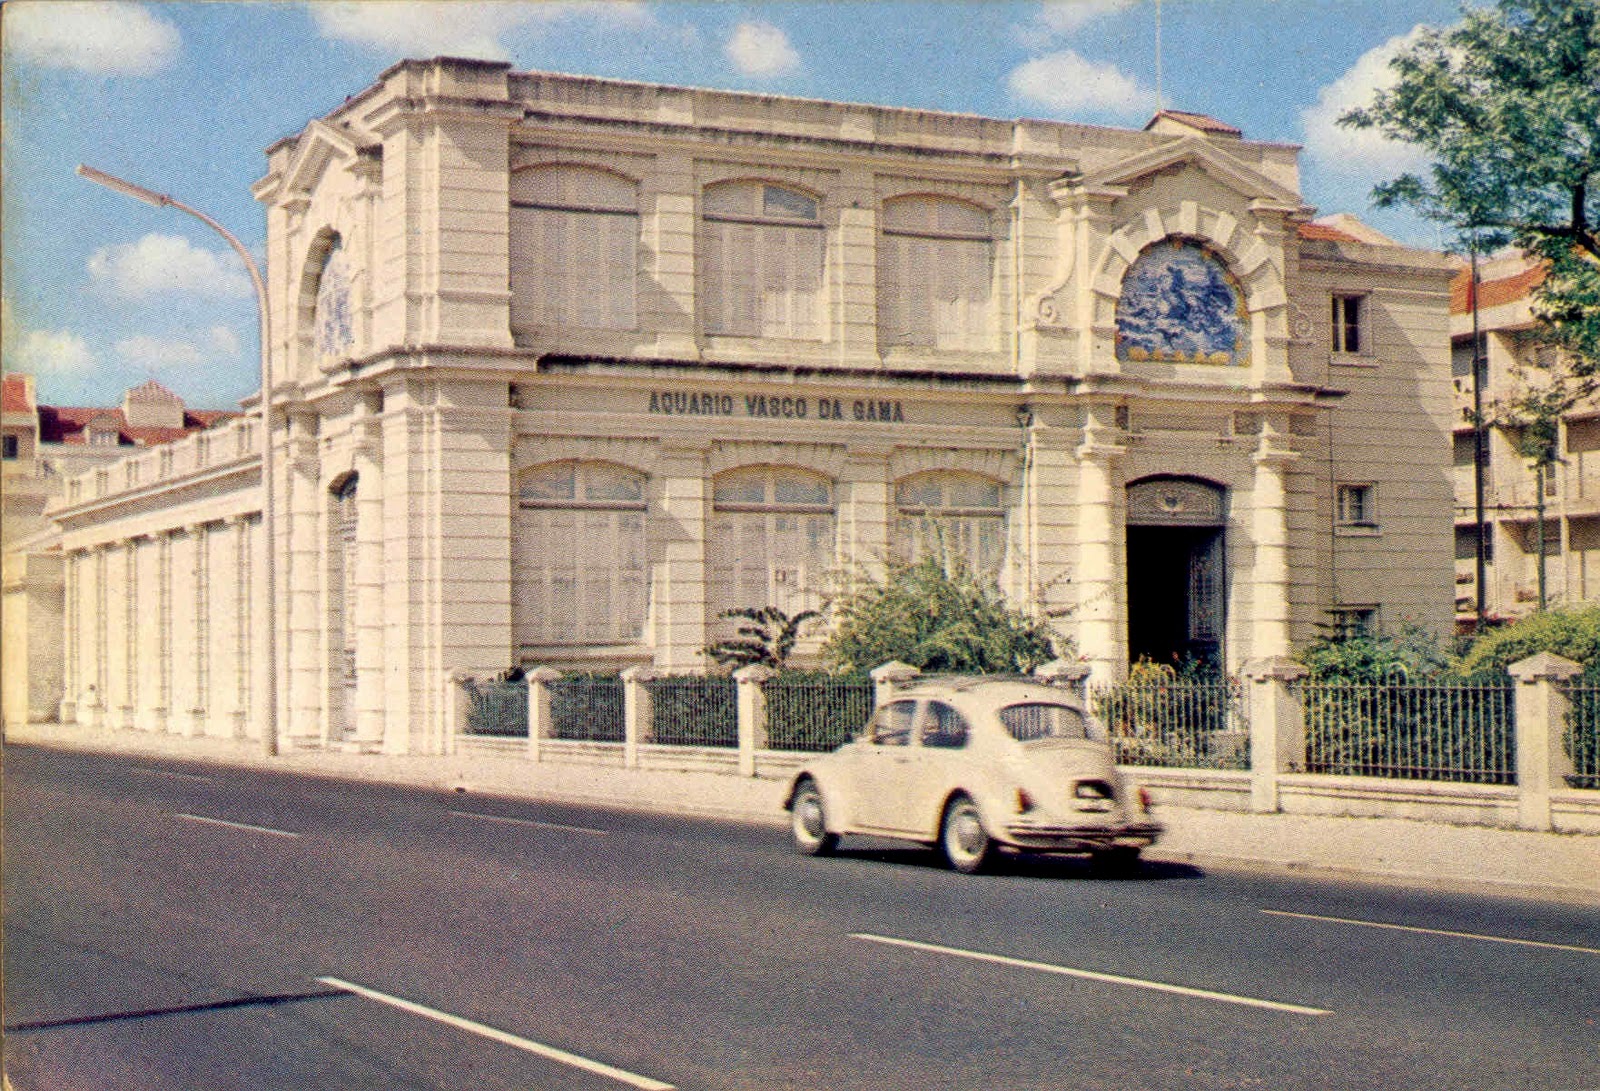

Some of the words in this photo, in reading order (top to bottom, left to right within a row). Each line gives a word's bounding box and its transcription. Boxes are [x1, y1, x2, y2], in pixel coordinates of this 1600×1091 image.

[648, 391, 734, 415] AQUARIO
[744, 395, 807, 418] VASCO
[818, 400, 843, 420] DA
[852, 401, 904, 422] GAMA
